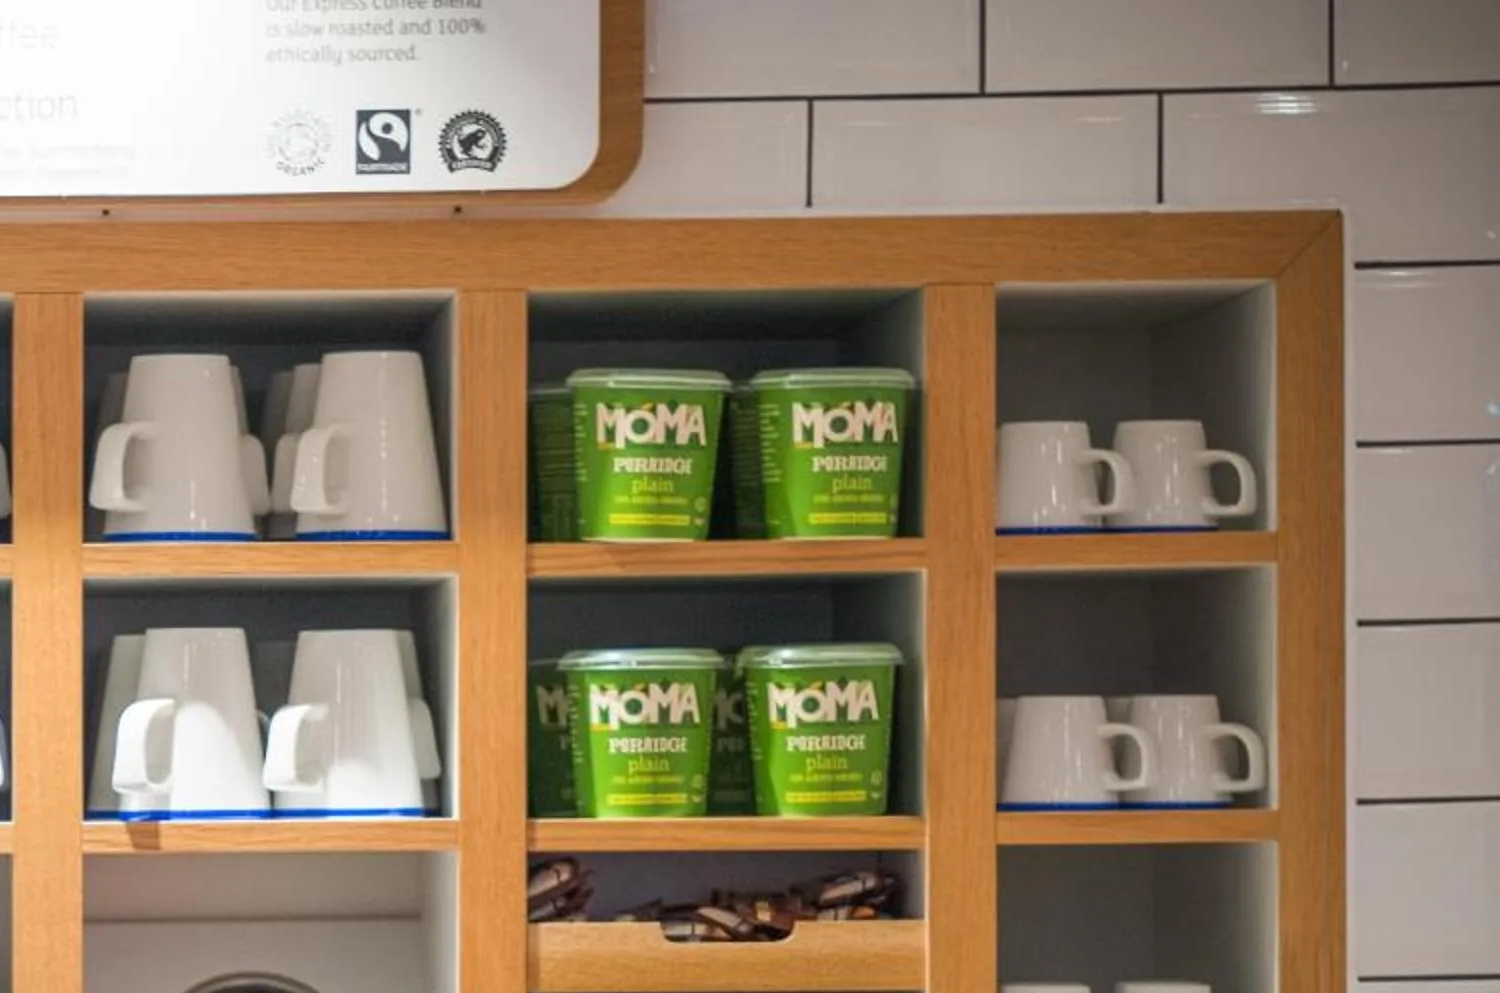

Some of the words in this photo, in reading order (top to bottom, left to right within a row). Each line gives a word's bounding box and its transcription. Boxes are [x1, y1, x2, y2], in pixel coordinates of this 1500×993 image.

[329, 18, 394, 35] roasted
[399, 18, 432, 35] and
[438, 18, 486, 34] 100%
[266, 46, 342, 66] ethically
[596, 402, 706, 449] MOMA
[792, 401, 898, 449] MOMA
[632, 475, 674, 496] plain
[832, 473, 873, 494] plain
[589, 681, 700, 732] MOMA
[767, 680, 879, 729] MOMA
[628, 755, 670, 774] plain
[806, 755, 848, 774] plain
